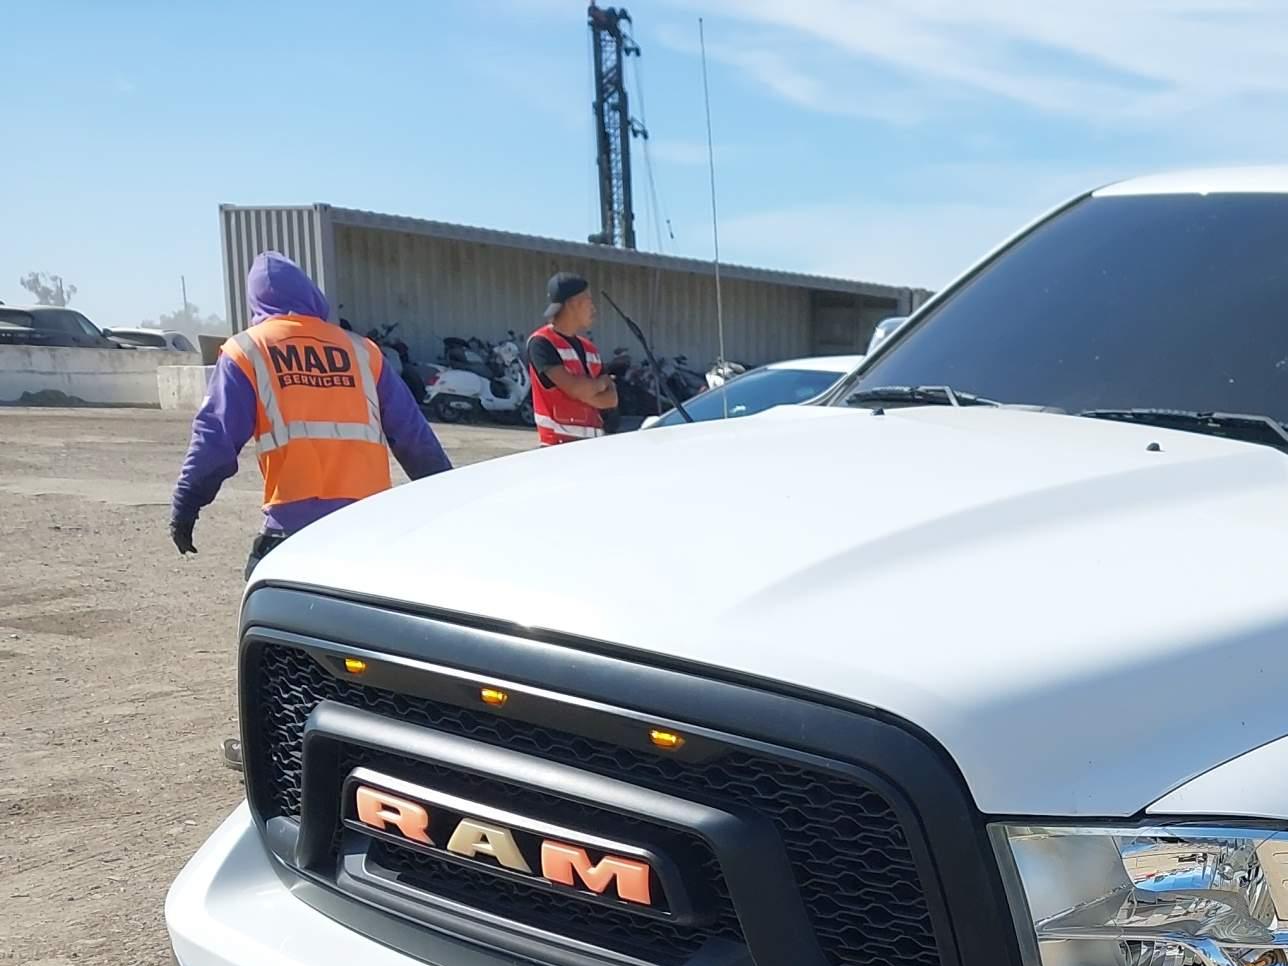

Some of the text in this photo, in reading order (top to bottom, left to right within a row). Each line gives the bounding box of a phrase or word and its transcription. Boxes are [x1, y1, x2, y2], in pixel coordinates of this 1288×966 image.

[267, 344, 352, 374] MAD
[283, 374, 351, 387] SERVICES
[356, 785, 651, 905] RAM
